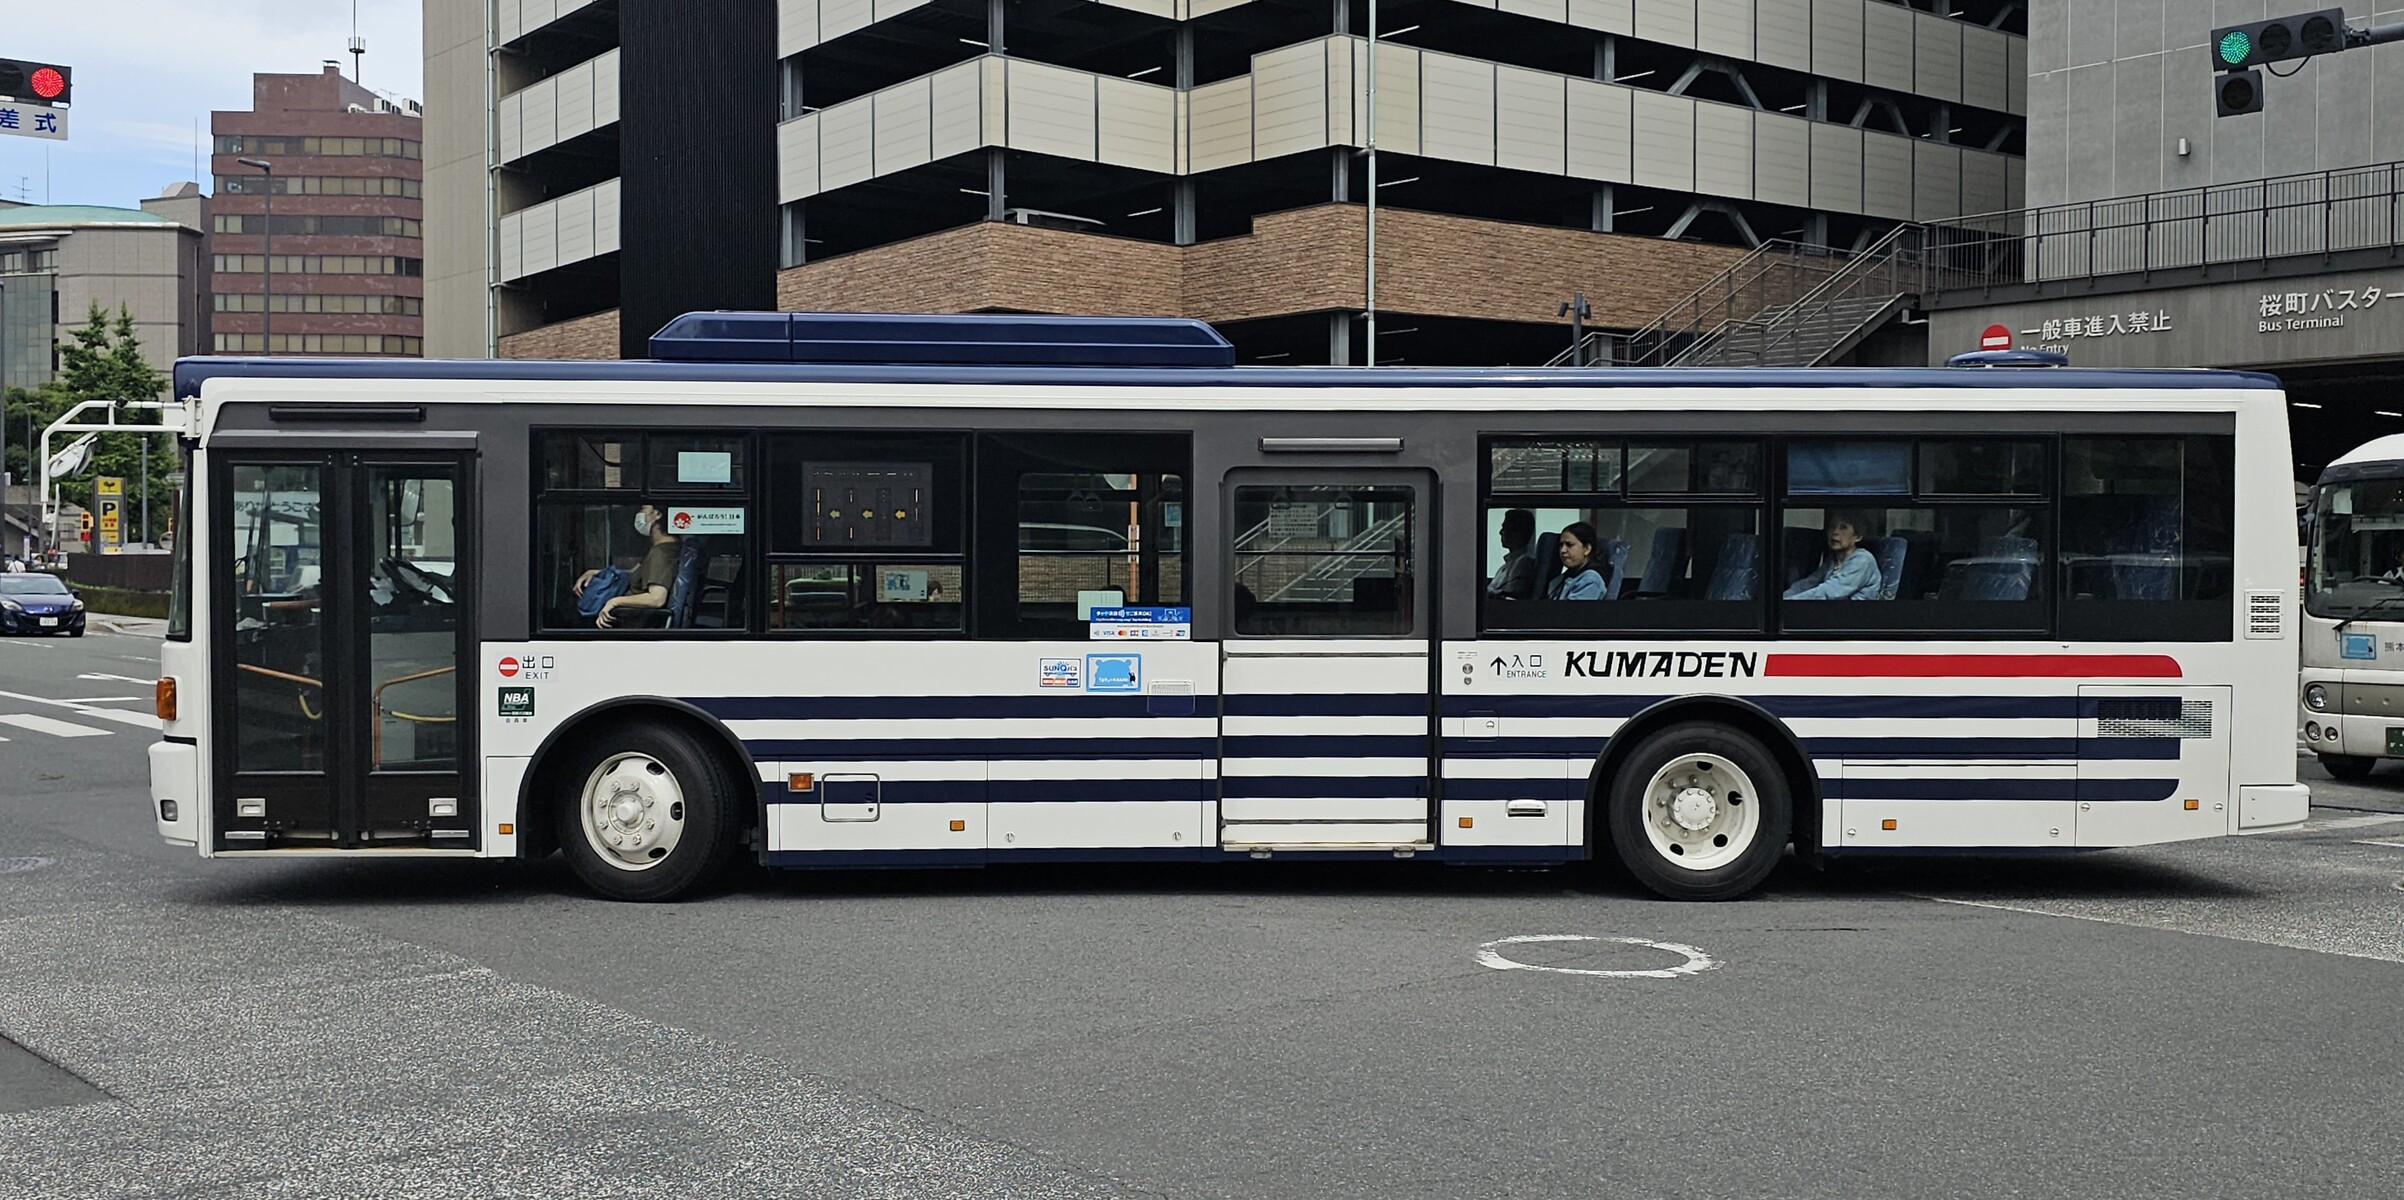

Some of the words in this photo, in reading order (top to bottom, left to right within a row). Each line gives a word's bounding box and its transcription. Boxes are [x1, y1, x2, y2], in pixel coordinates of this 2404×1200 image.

[2259, 286, 2404, 318] 桜町バスター
[2020, 309, 2172, 341] 一般車進入禁止
[2258, 321, 2282, 332] Bus
[2285, 314, 2344, 330] Terminal
[2039, 343, 2069, 356] Entry
[102, 502, 116, 516] P
[522, 655, 554, 669] 出口
[1512, 654, 1542, 668] 入口
[1564, 651, 1757, 678] KUMADEN
[525, 671, 550, 680] EXIT
[1506, 670, 1547, 679] ENTRANCE
[503, 692, 530, 704] NBA
